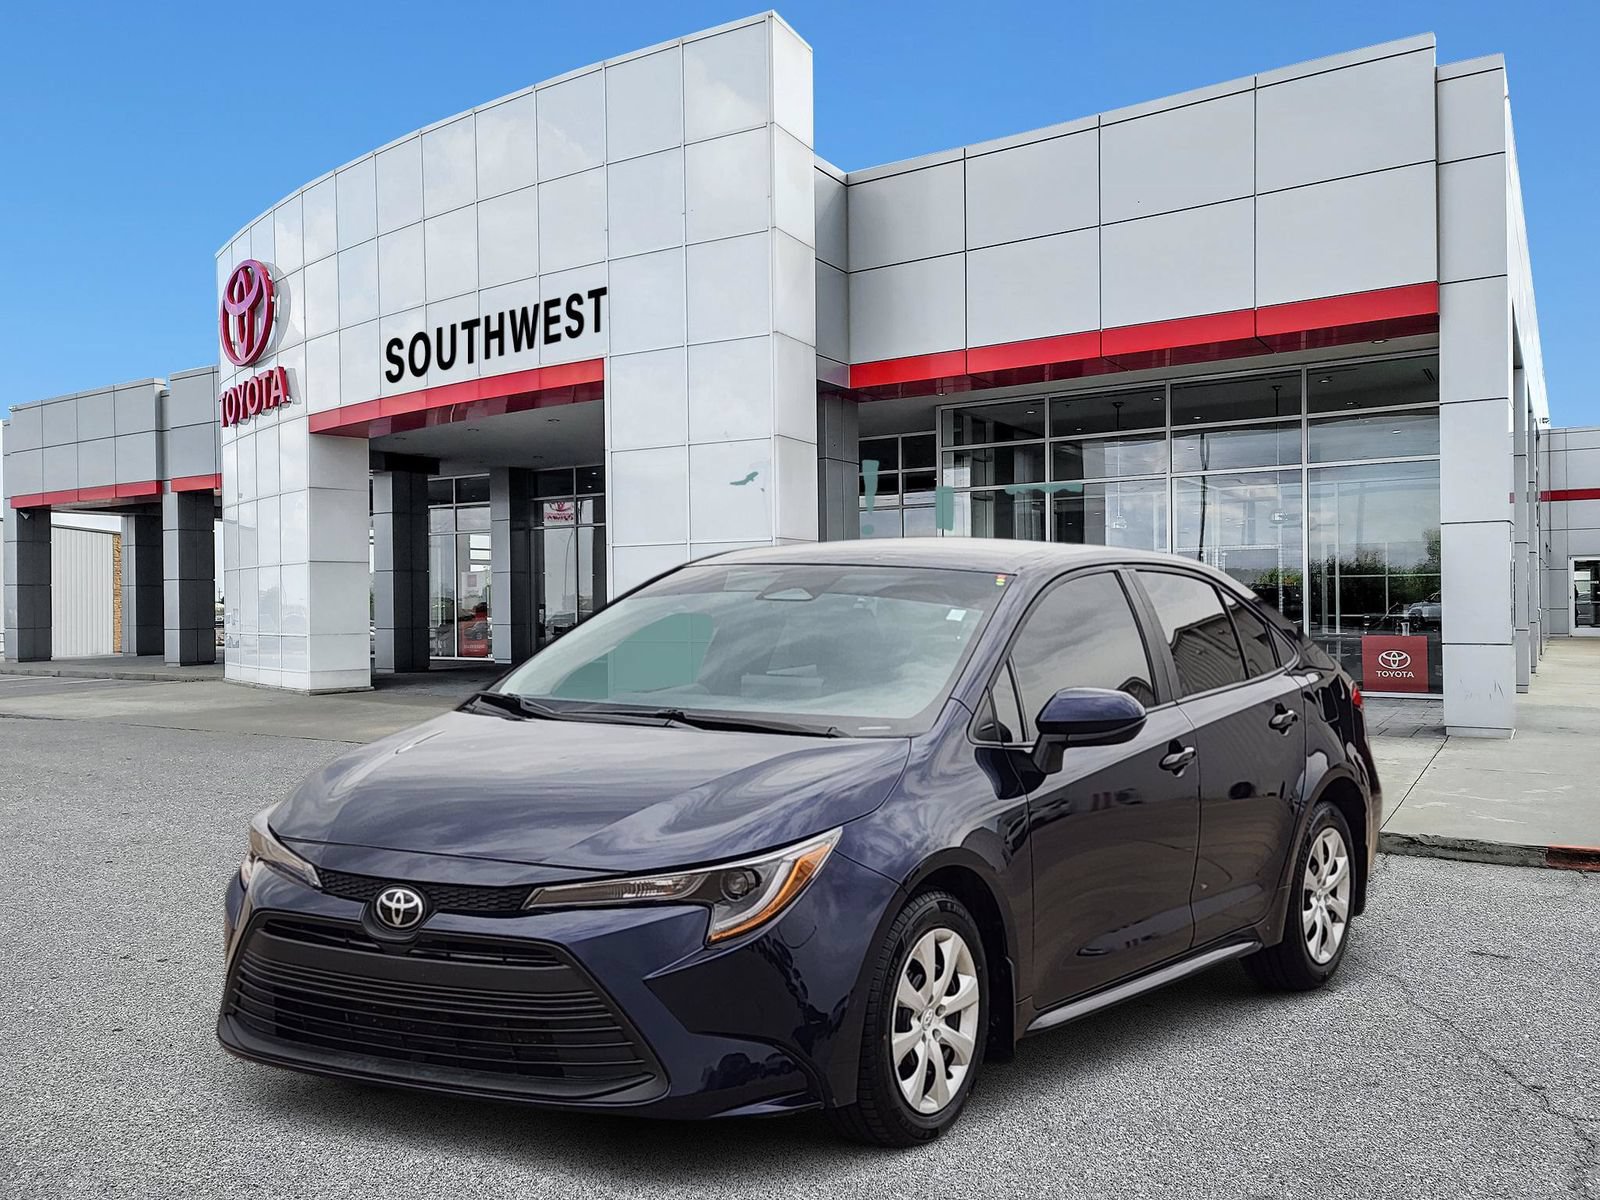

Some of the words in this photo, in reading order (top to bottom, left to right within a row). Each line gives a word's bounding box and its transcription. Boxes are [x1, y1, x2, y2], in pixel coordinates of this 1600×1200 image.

[385, 286, 607, 383] SOUTHWEST
[219, 366, 291, 427] TOYOTA
[1375, 670, 1415, 679] TOYOTA
